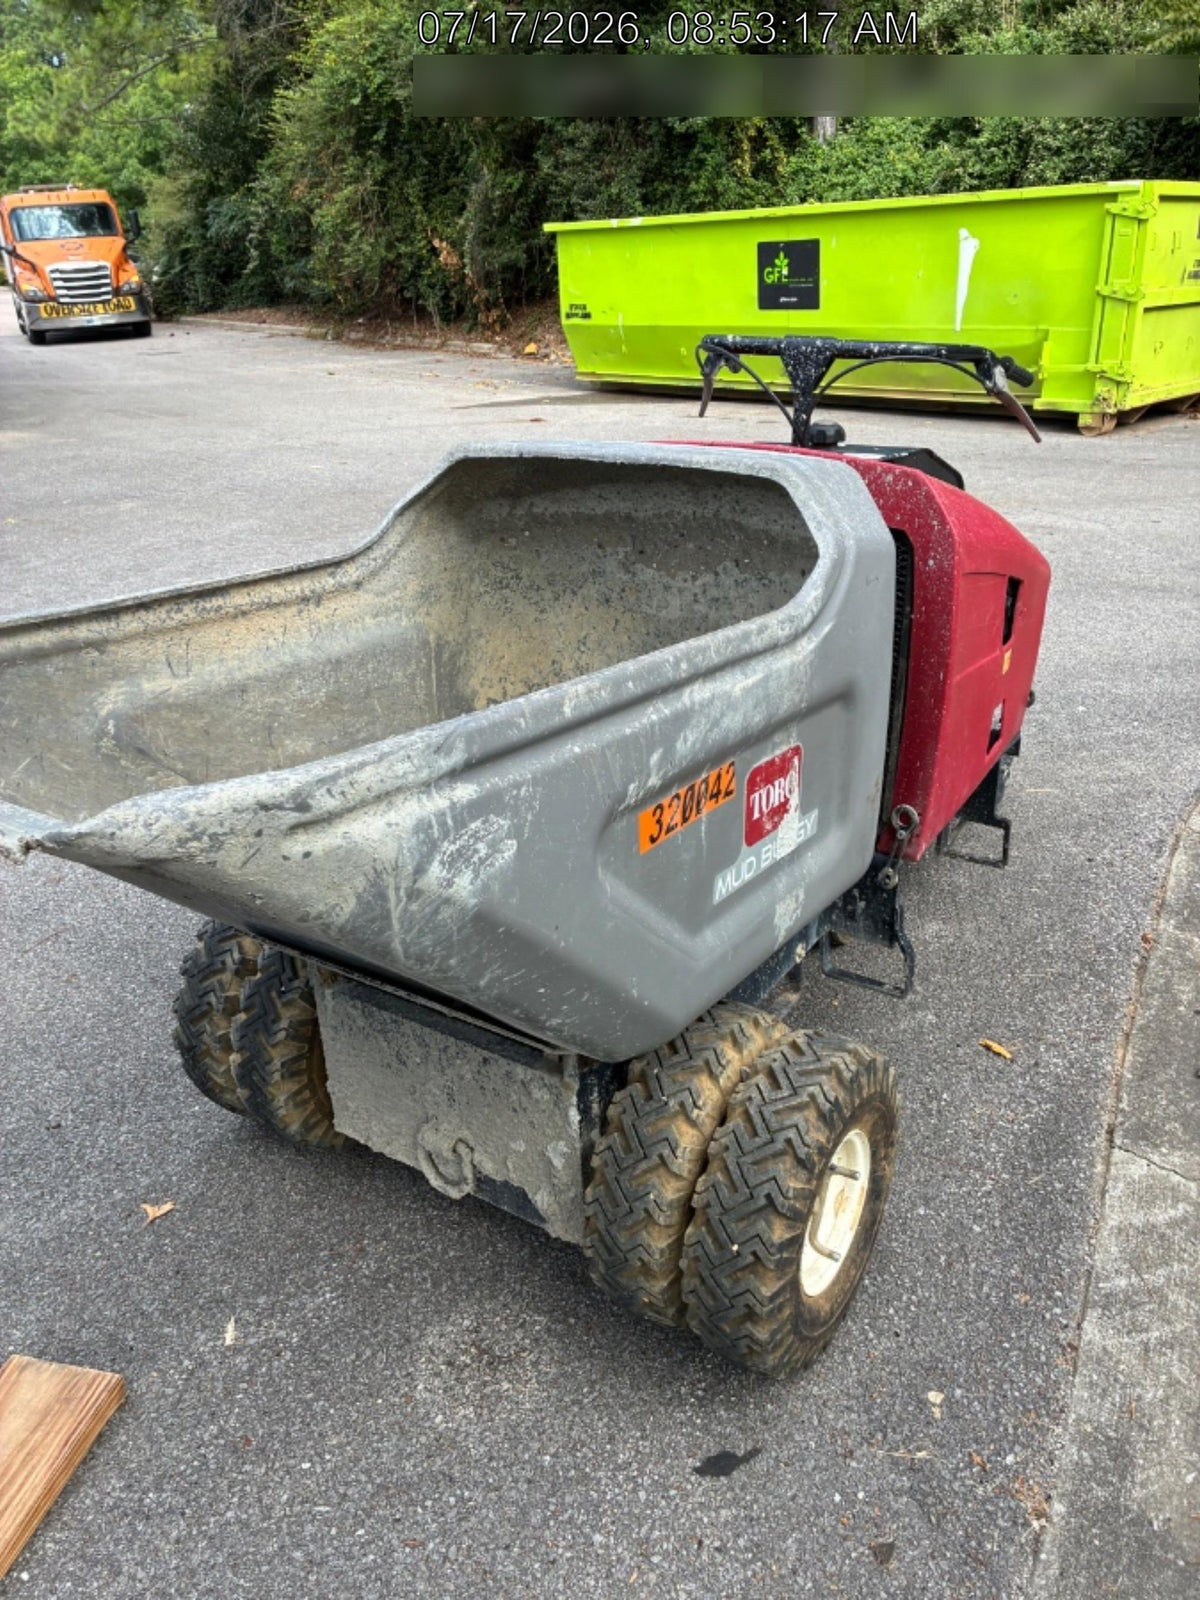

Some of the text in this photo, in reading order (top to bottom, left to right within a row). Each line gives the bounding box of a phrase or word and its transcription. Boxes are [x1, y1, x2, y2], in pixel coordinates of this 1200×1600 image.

[764, 266, 788, 284] GFL
[101, 297, 132, 313] LOAD
[649, 761, 735, 844] 320042
[714, 856, 757, 901] MUD
